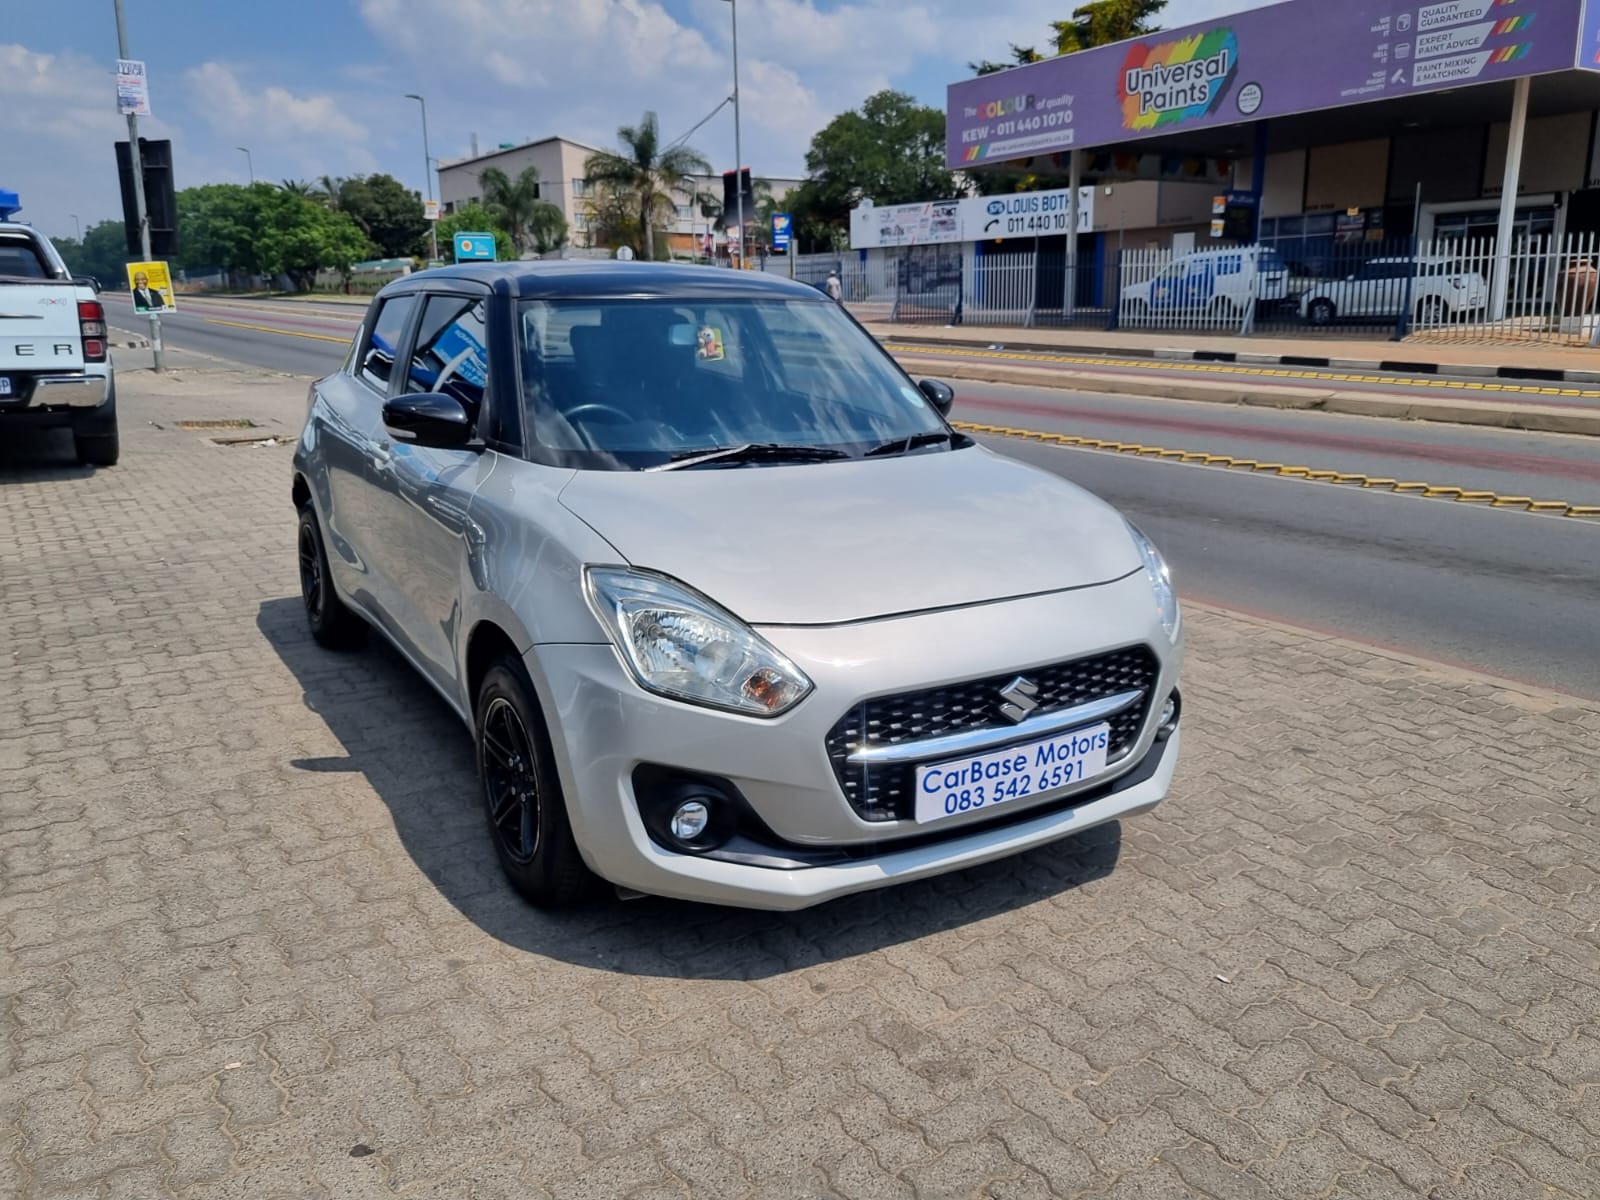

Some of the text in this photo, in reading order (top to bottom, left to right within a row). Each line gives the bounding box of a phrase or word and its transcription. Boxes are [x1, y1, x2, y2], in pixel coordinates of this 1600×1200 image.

[1420, 8, 1482, 27] GUARANTEED
[1421, 4, 1459, 18] QUALITY
[1418, 37, 1480, 54] PAINT ADVICE
[1419, 33, 1453, 46] EXPERT
[1128, 52, 1226, 92] Universal
[1416, 57, 1477, 73] PAINT MIXING
[1423, 67, 1470, 80] MATCHING
[1142, 83, 1207, 112] Paints
[964, 94, 1074, 120] The COLOUR of quality
[962, 126, 989, 143] KEW
[997, 121, 1015, 136] 011
[1017, 116, 1040, 132] 440
[1042, 110, 1073, 127] 1070
[1006, 197, 1038, 214] LOUIS
[1007, 217, 1024, 233] 011
[1027, 215, 1050, 231] 440
[0, 380, 9, 392] P
[922, 732, 1107, 793] CarBase Motors
[944, 760, 1084, 814] 083 542 6591
